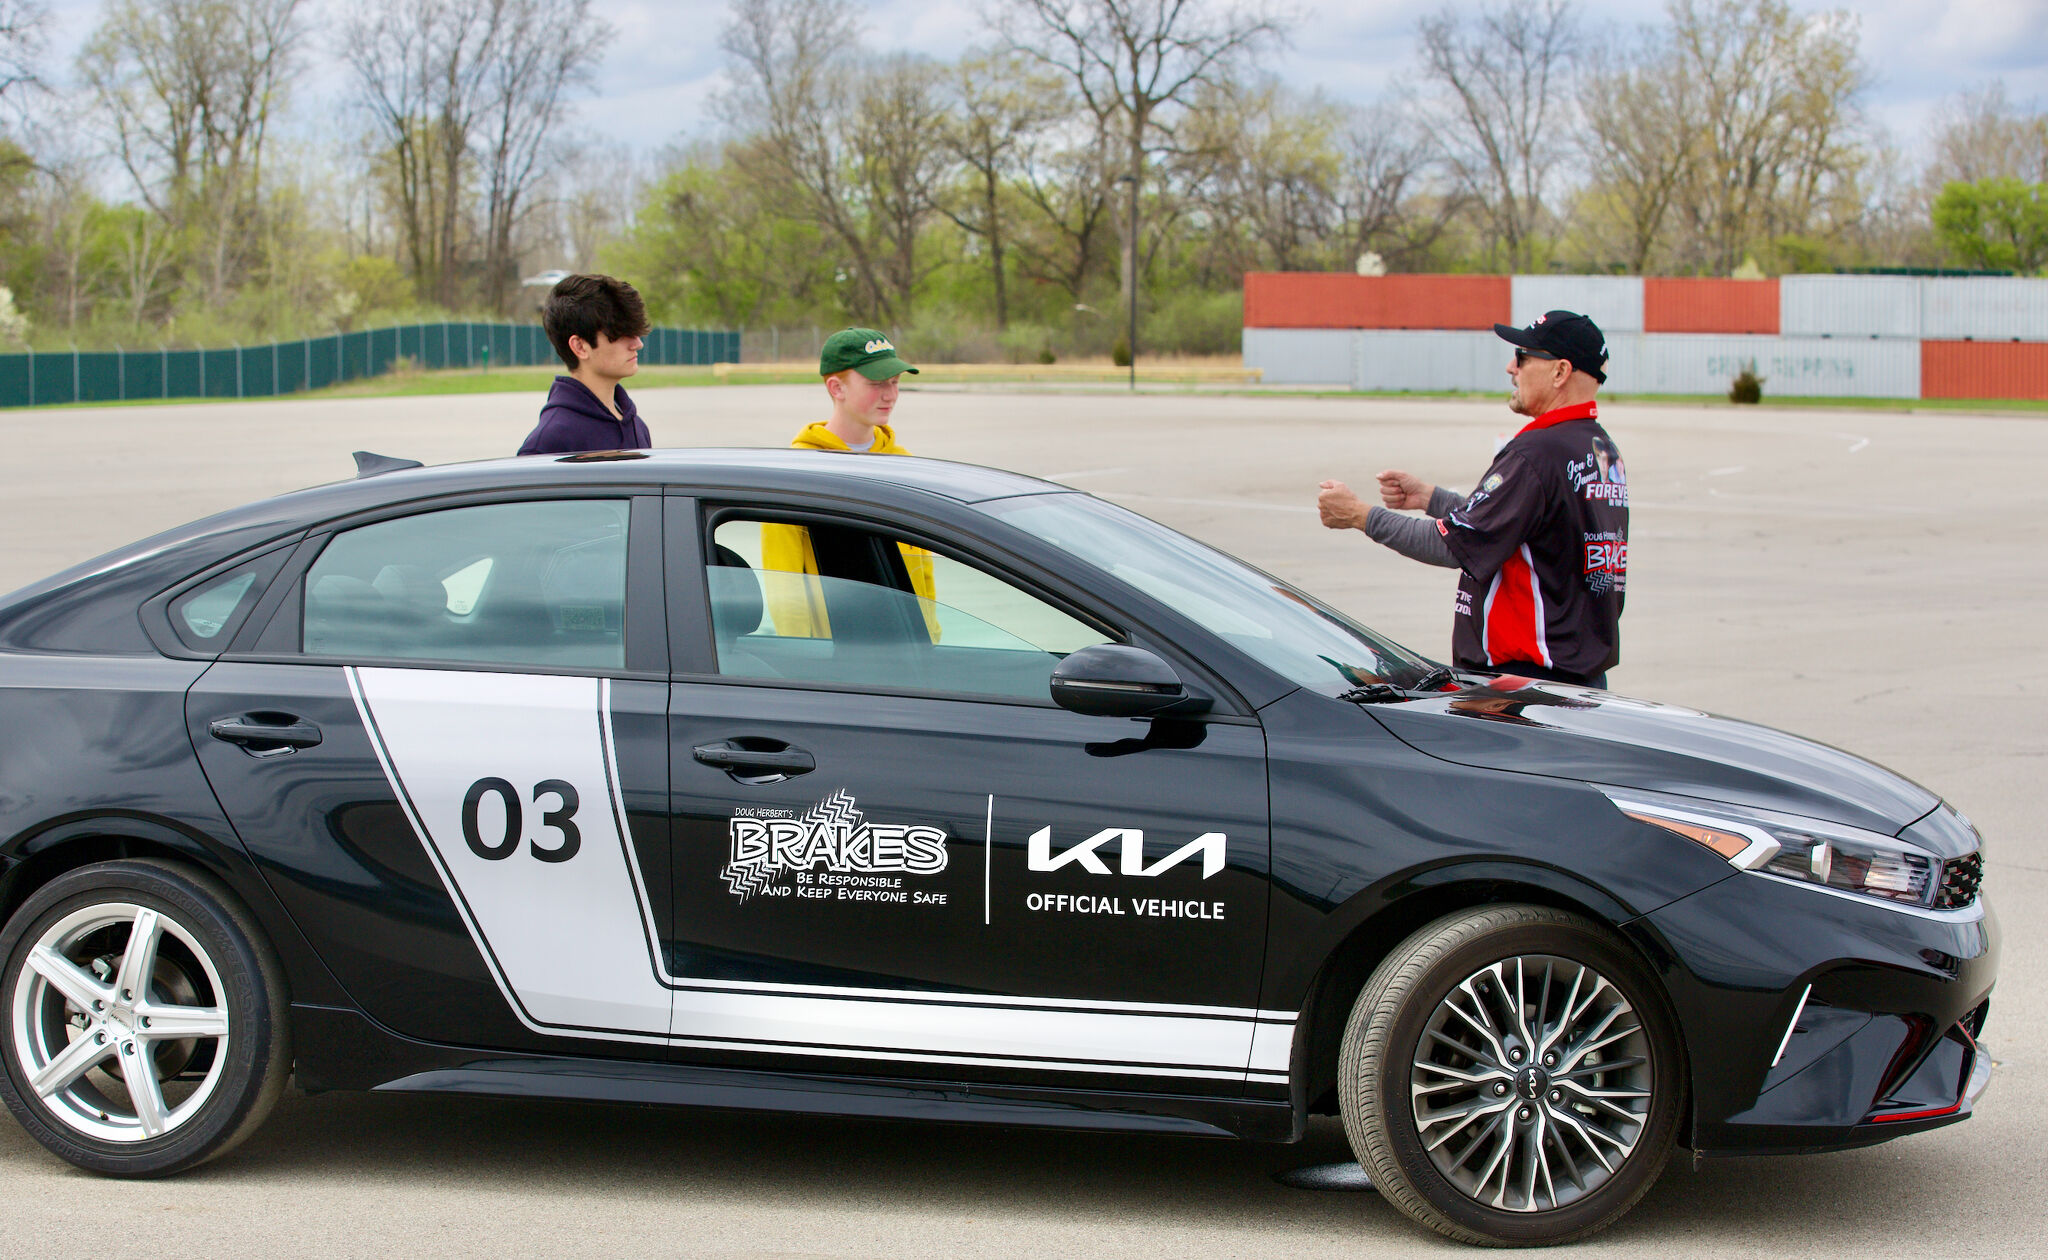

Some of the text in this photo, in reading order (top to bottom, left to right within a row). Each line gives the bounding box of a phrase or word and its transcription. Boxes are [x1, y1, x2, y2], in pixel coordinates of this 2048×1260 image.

[462, 777, 581, 863] 03
[735, 808, 793, 818] DOUG HERBERT'S
[1028, 825, 1227, 880] KIA
[1026, 893, 1225, 920] OFFICIAL VEHICLE
